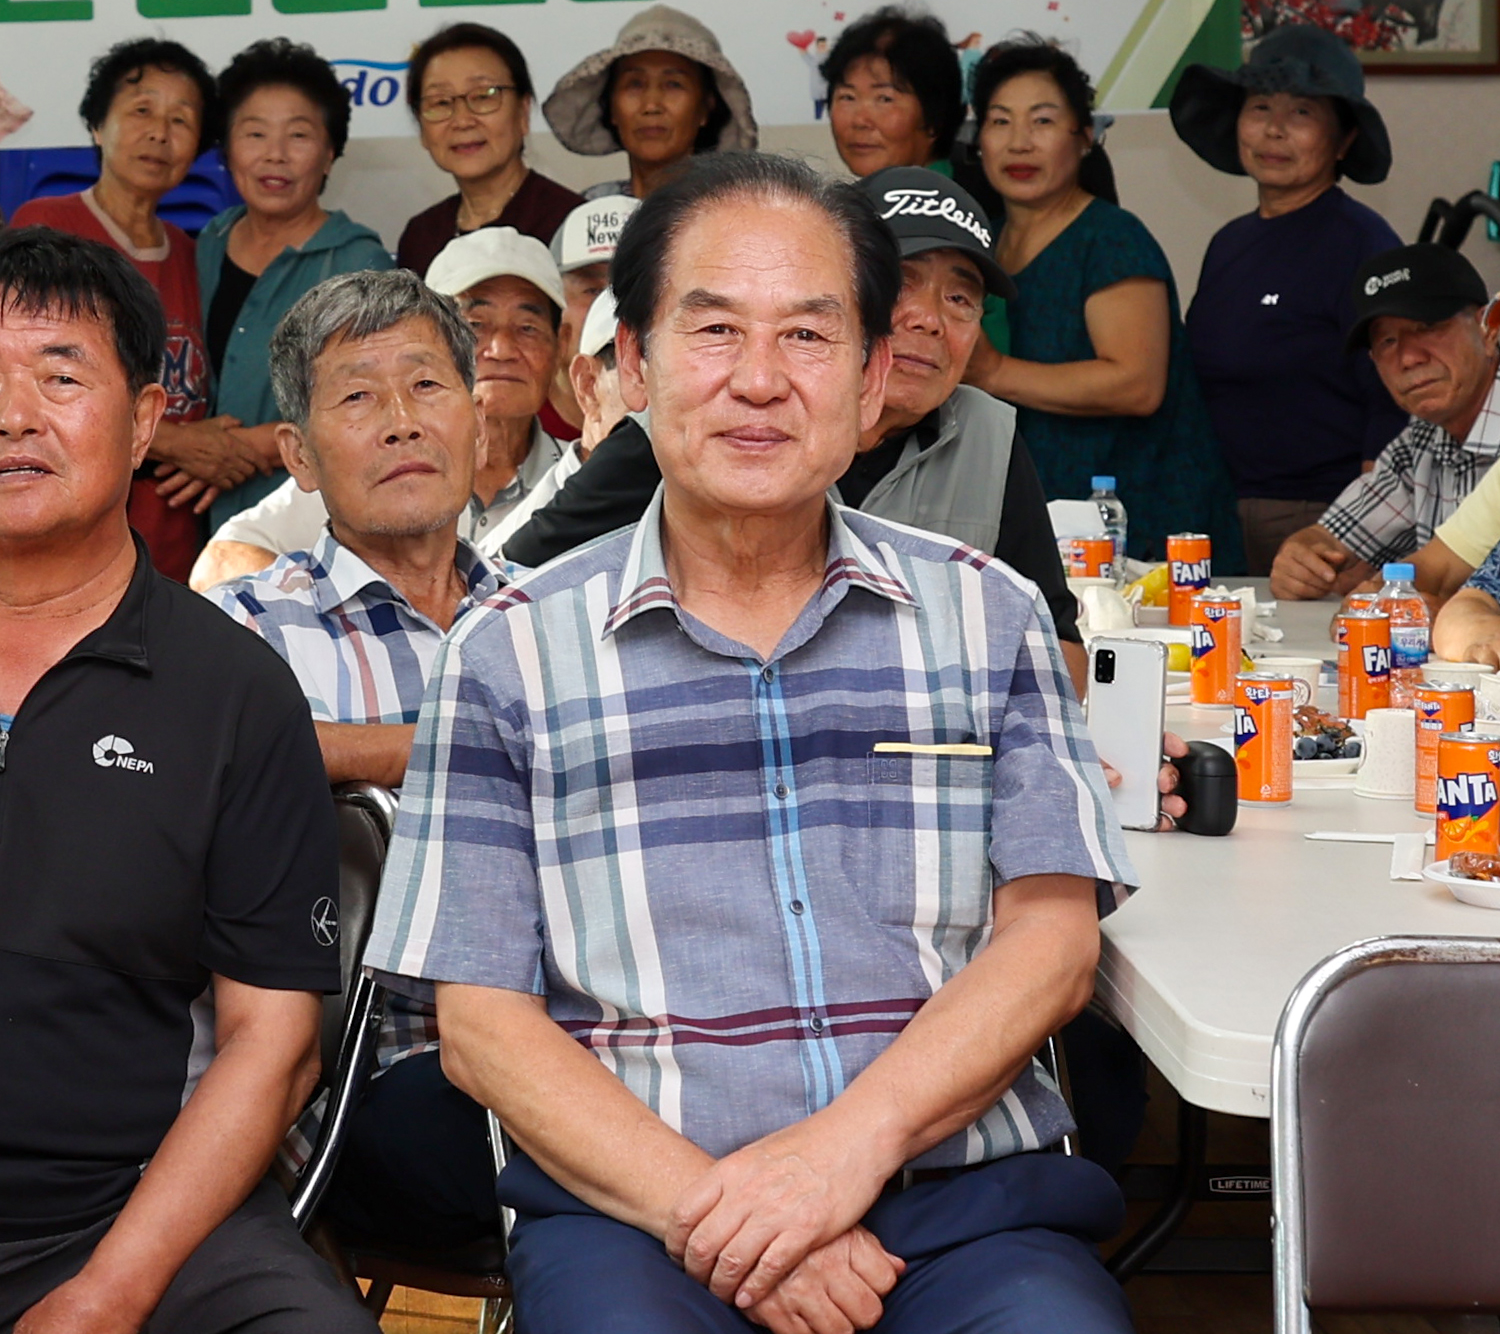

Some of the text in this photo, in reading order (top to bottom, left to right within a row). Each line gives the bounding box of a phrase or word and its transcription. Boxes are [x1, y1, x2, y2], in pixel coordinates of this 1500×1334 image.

[880, 188, 992, 248] Titleist
[1244, 686, 1272, 701] 환타
[115, 755, 155, 774] NEPA
[1217, 1180, 1270, 1190] LIFETIME
